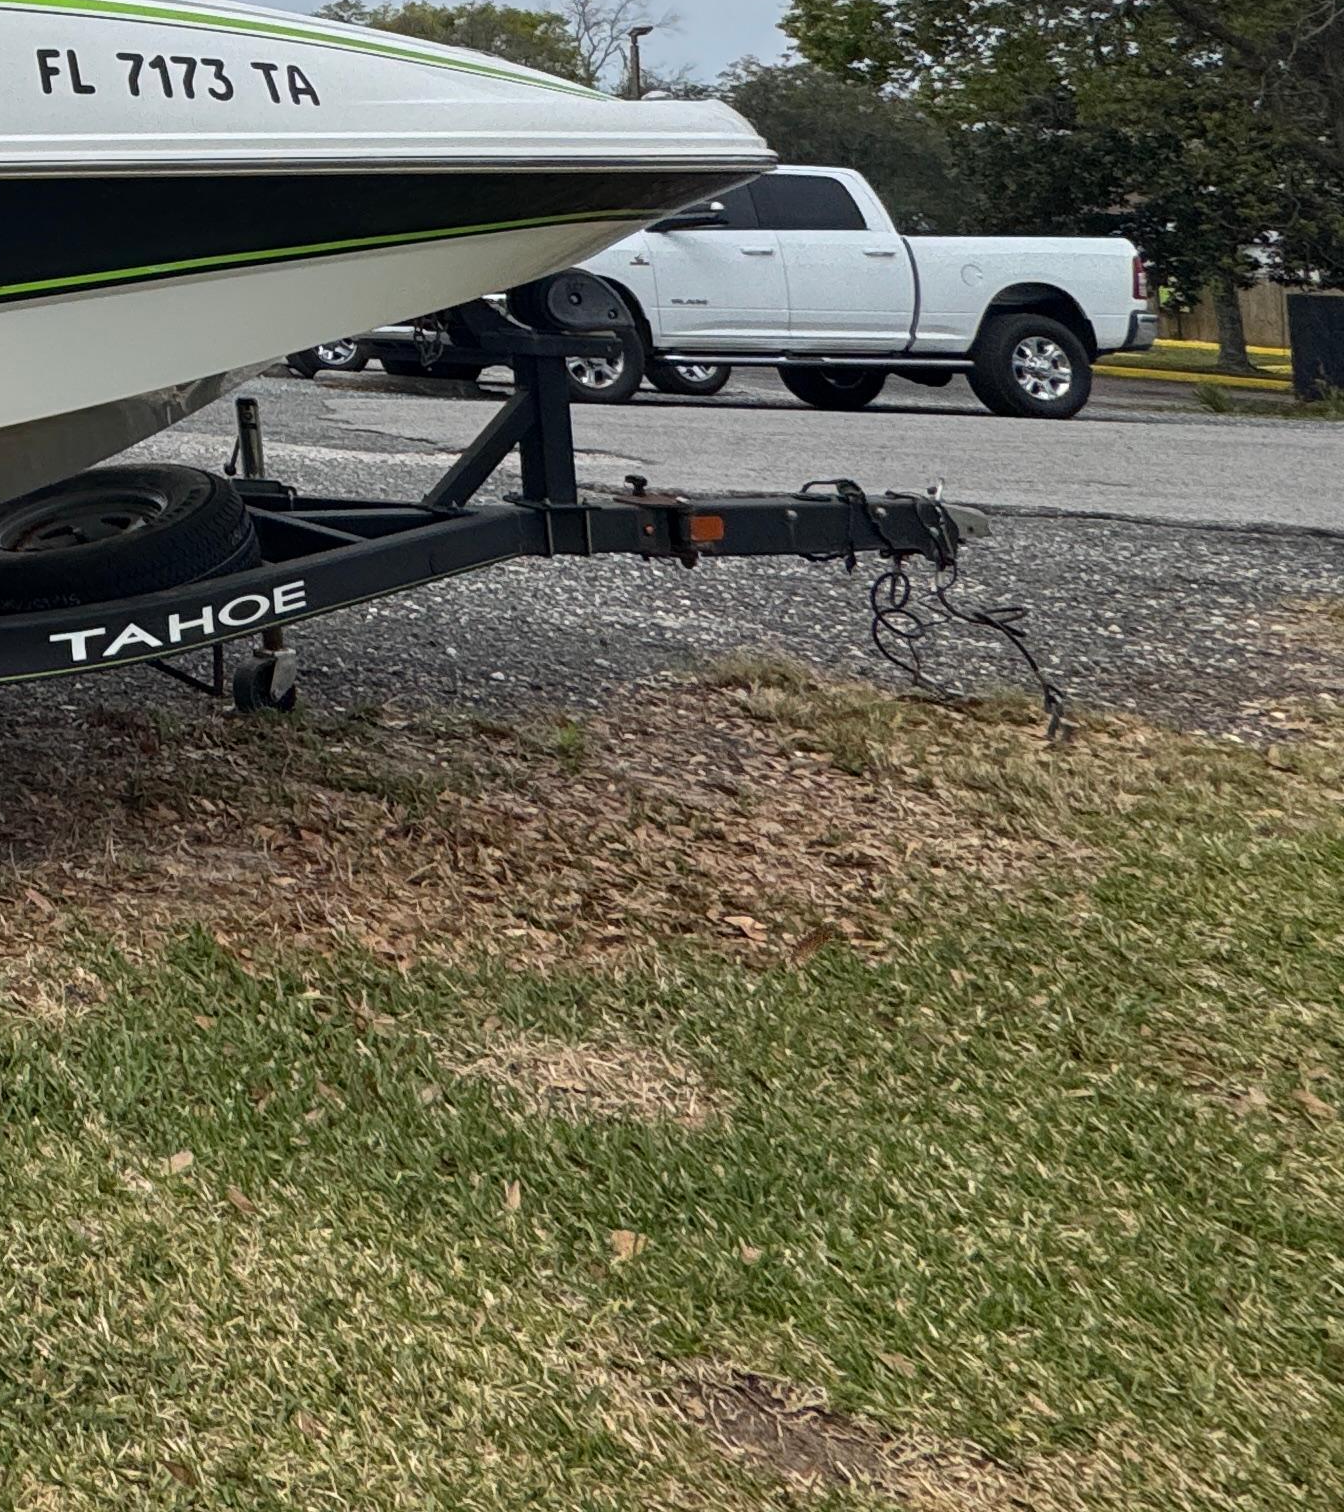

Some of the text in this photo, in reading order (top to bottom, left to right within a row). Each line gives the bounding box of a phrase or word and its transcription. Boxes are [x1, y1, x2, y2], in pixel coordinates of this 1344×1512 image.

[36, 48, 321, 106] FL 7173 TA
[49, 579, 307, 661] TAHOE
